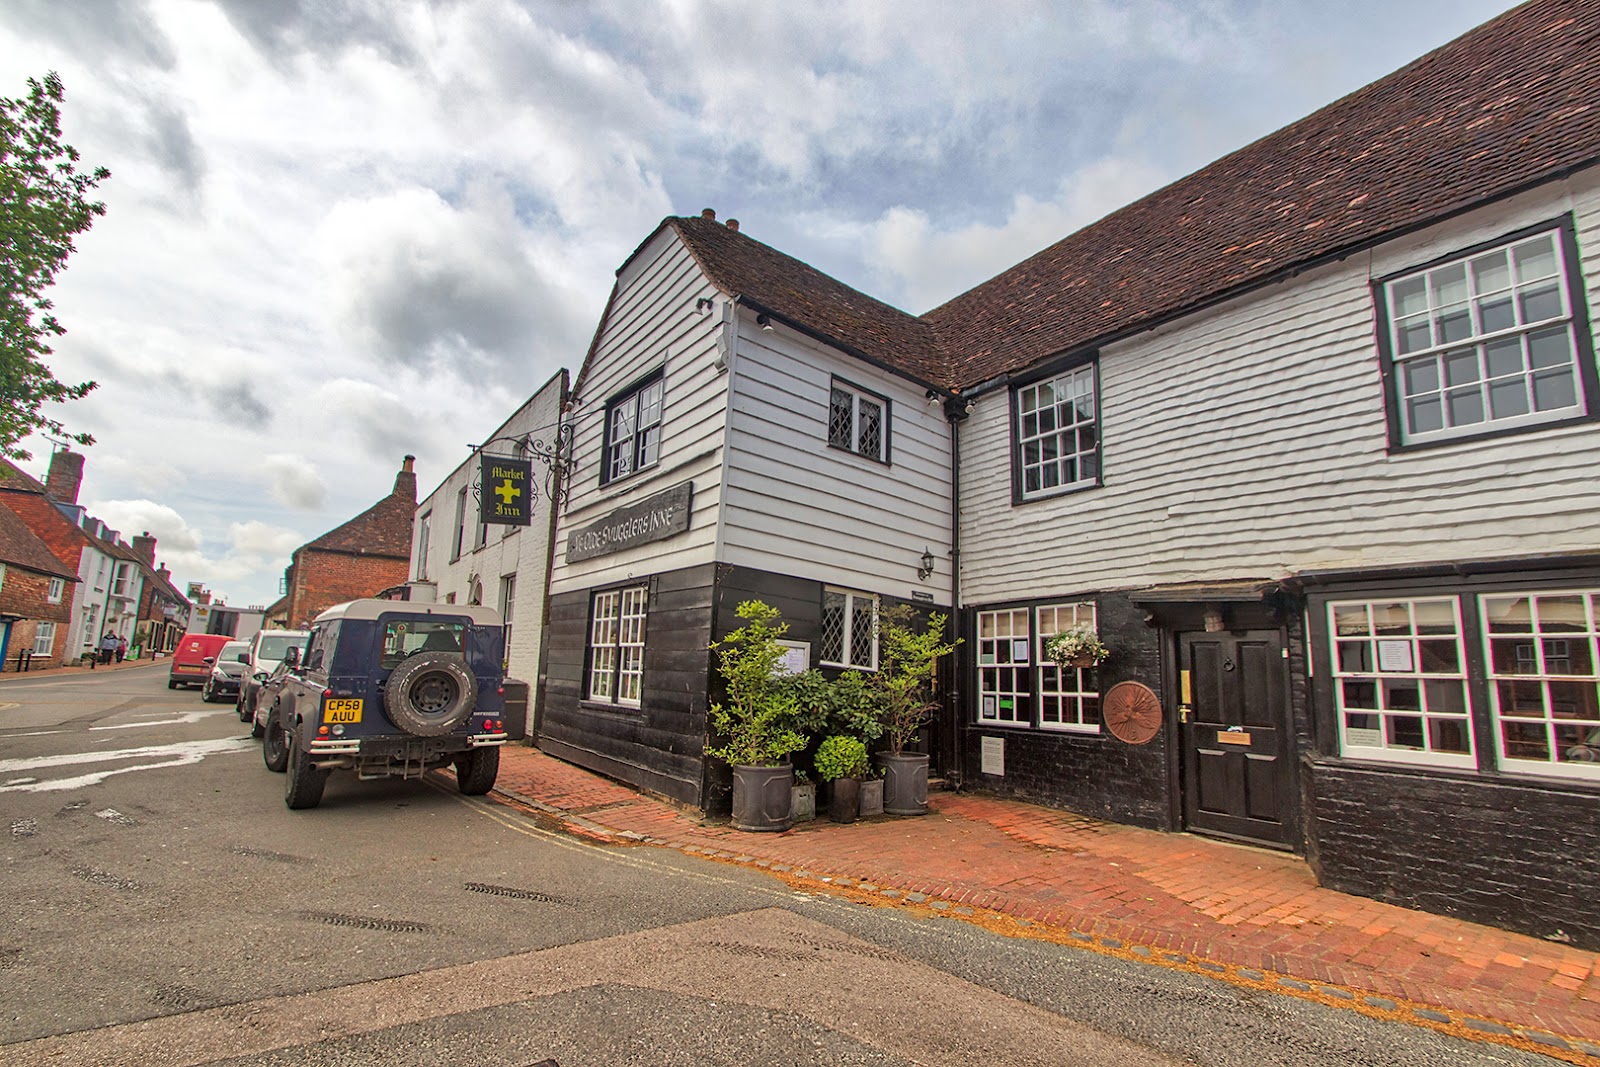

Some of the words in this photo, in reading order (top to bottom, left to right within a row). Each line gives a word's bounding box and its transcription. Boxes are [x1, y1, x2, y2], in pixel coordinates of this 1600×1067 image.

[492, 466, 525, 480] Market
[495, 502, 520, 516] Inn
[602, 515, 649, 545] SMUGGLERS
[649, 507, 674, 532] INNE
[328, 700, 360, 711] CP58
[331, 711, 355, 722] AUU
